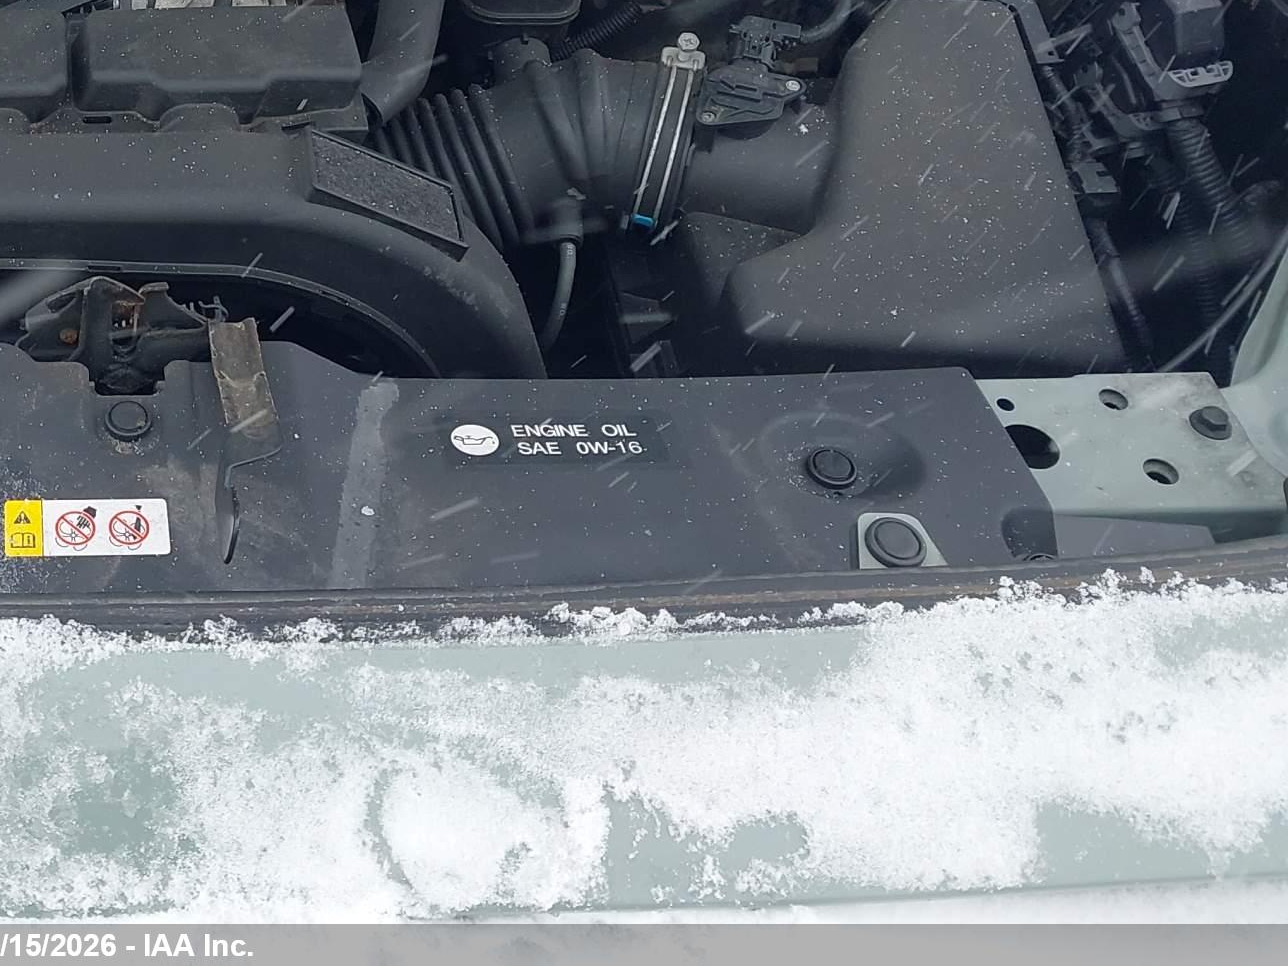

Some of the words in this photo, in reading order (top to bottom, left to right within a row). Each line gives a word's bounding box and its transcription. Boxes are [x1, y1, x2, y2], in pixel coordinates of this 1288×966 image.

[510, 424, 589, 438] ENGINE
[601, 424, 638, 438] OIL
[517, 441, 562, 455] SAE
[576, 441, 643, 454] 0W-16
